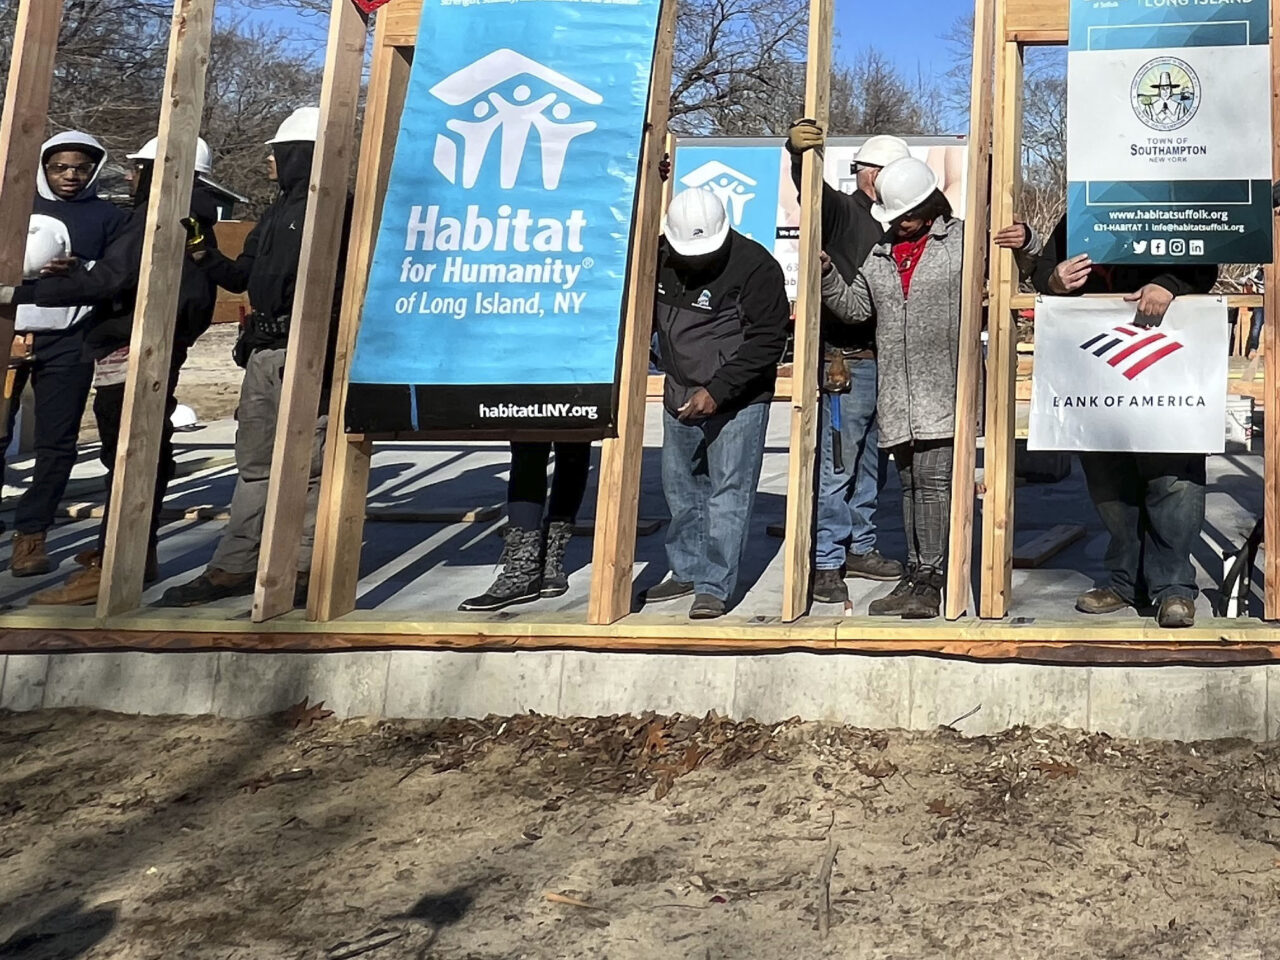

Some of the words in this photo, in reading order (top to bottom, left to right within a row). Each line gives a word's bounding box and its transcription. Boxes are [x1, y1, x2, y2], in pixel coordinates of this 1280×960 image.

[1109, 209, 1228, 221] www.habitatsuffolk.org
[404, 204, 588, 253] Habitat
[1093, 223, 1142, 232] 631-HABITAT
[1151, 222, 1245, 233] info@habitatsuffolk.org
[399, 257, 436, 283] for
[395, 292, 415, 314] of
[419, 292, 467, 319] Long
[474, 292, 545, 318] Island,
[553, 292, 587, 314] NY
[1104, 395, 1124, 407] OF
[1129, 395, 1206, 407] AMERICA
[479, 403, 598, 420] habitatLINY.org
